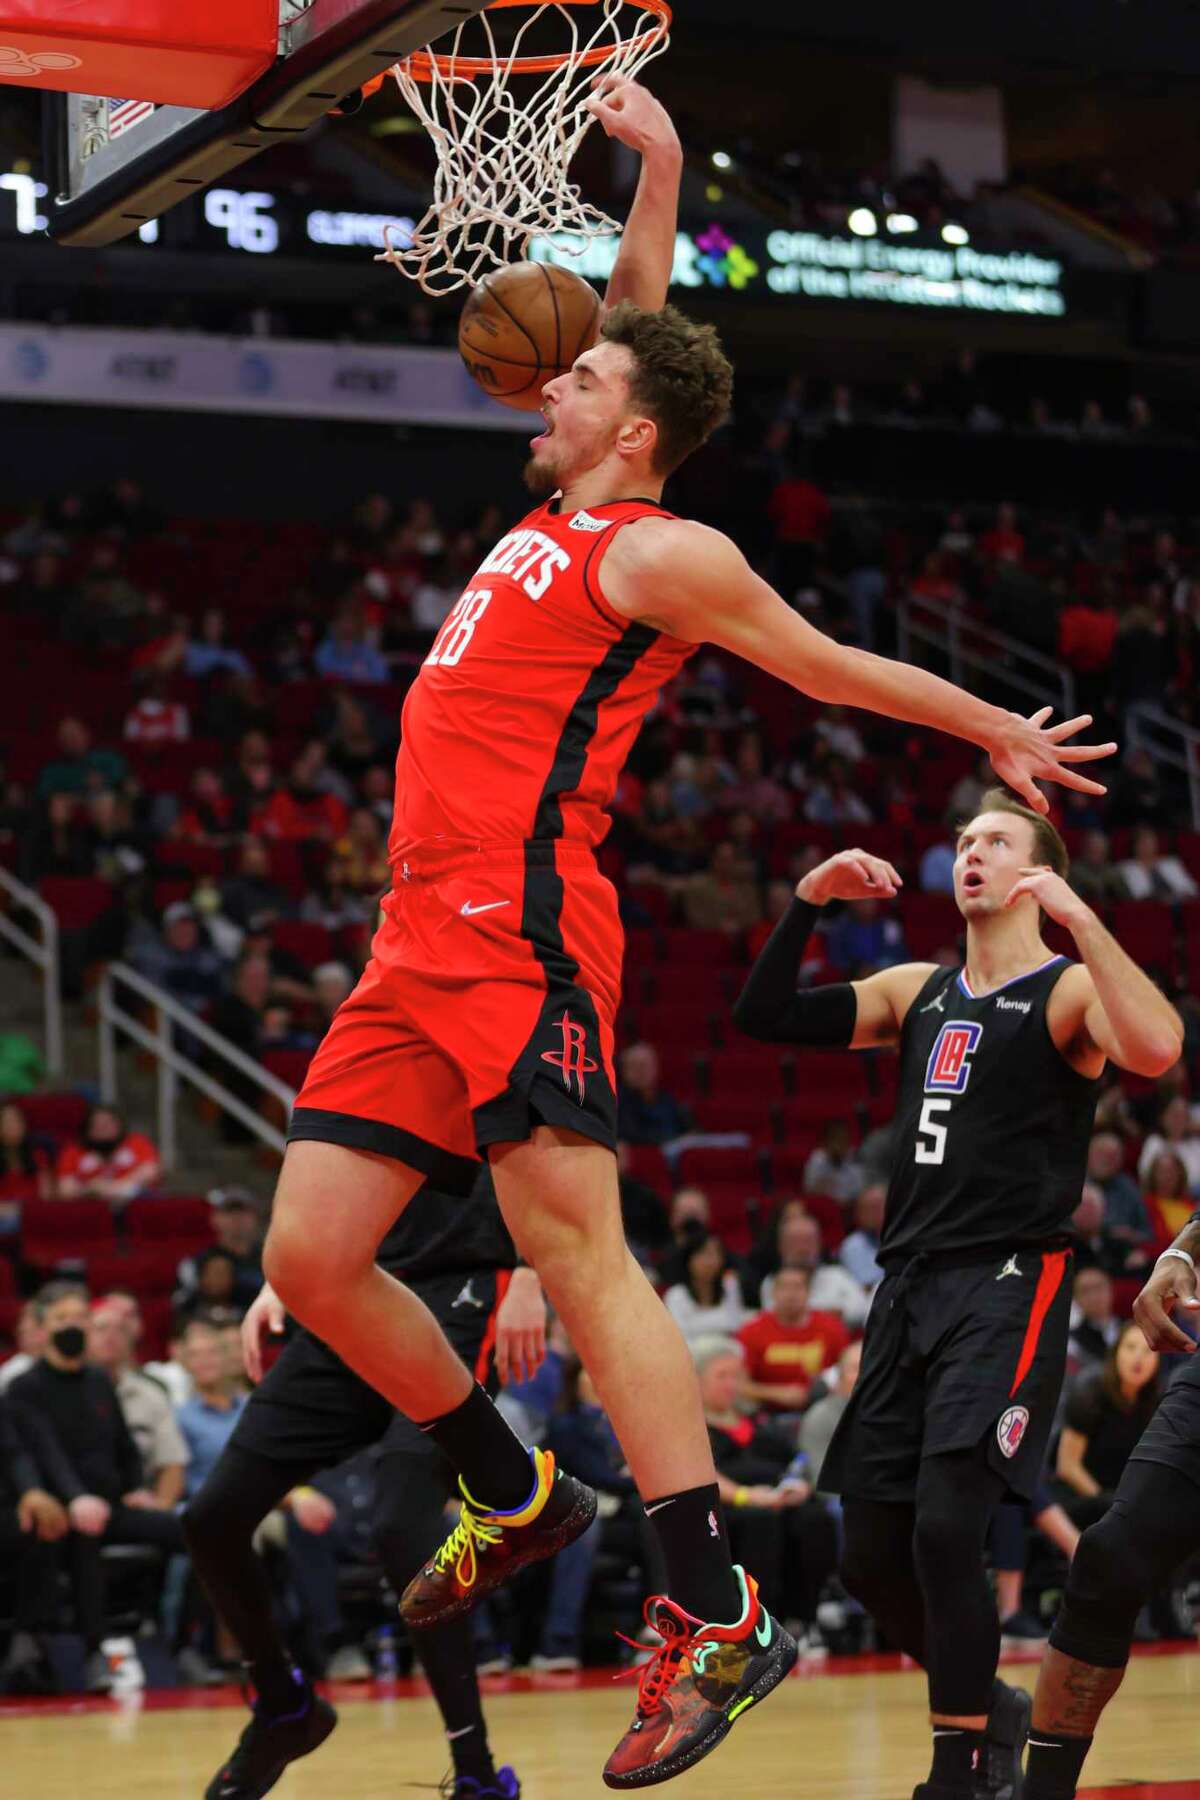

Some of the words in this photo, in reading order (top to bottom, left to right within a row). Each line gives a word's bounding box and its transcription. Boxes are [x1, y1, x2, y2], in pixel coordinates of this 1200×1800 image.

[204, 188, 279, 253] 96
[766, 229, 862, 267] Official
[864, 238, 952, 281] Energy
[956, 246, 1061, 285] Provider
[766, 262, 799, 294] of
[801, 266, 848, 298] the
[422, 588, 493, 667] 28
[914, 1098, 952, 1166] 5
